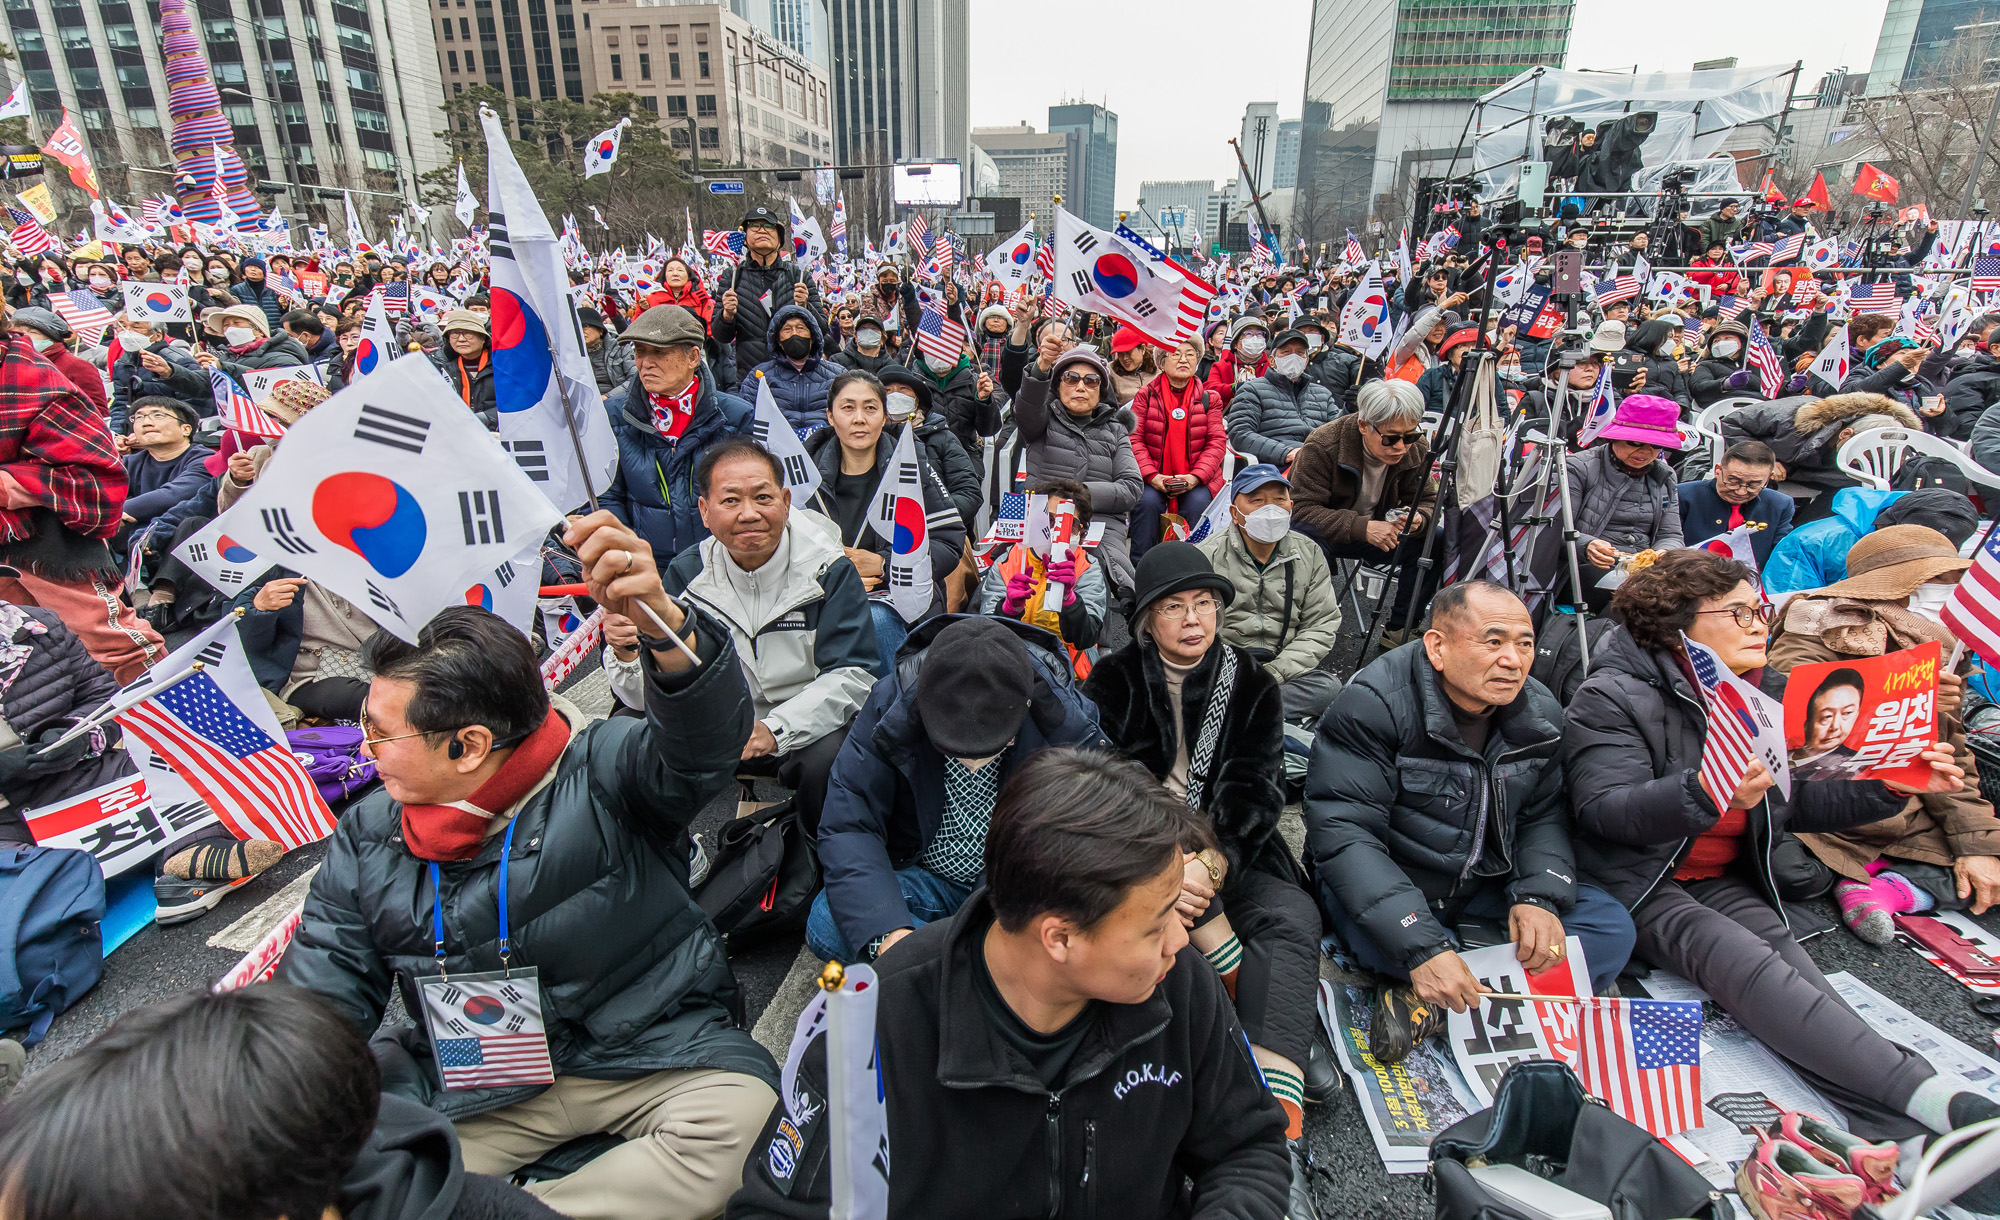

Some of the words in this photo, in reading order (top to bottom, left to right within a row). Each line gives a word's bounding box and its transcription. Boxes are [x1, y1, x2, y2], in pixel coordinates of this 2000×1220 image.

[1790, 293, 1815, 306] 무효
[1794, 280, 1817, 293] 원천
[1883, 657, 1936, 694] 사기탄핵
[1865, 689, 1934, 743] 원천
[1840, 738, 1930, 772] 무효
